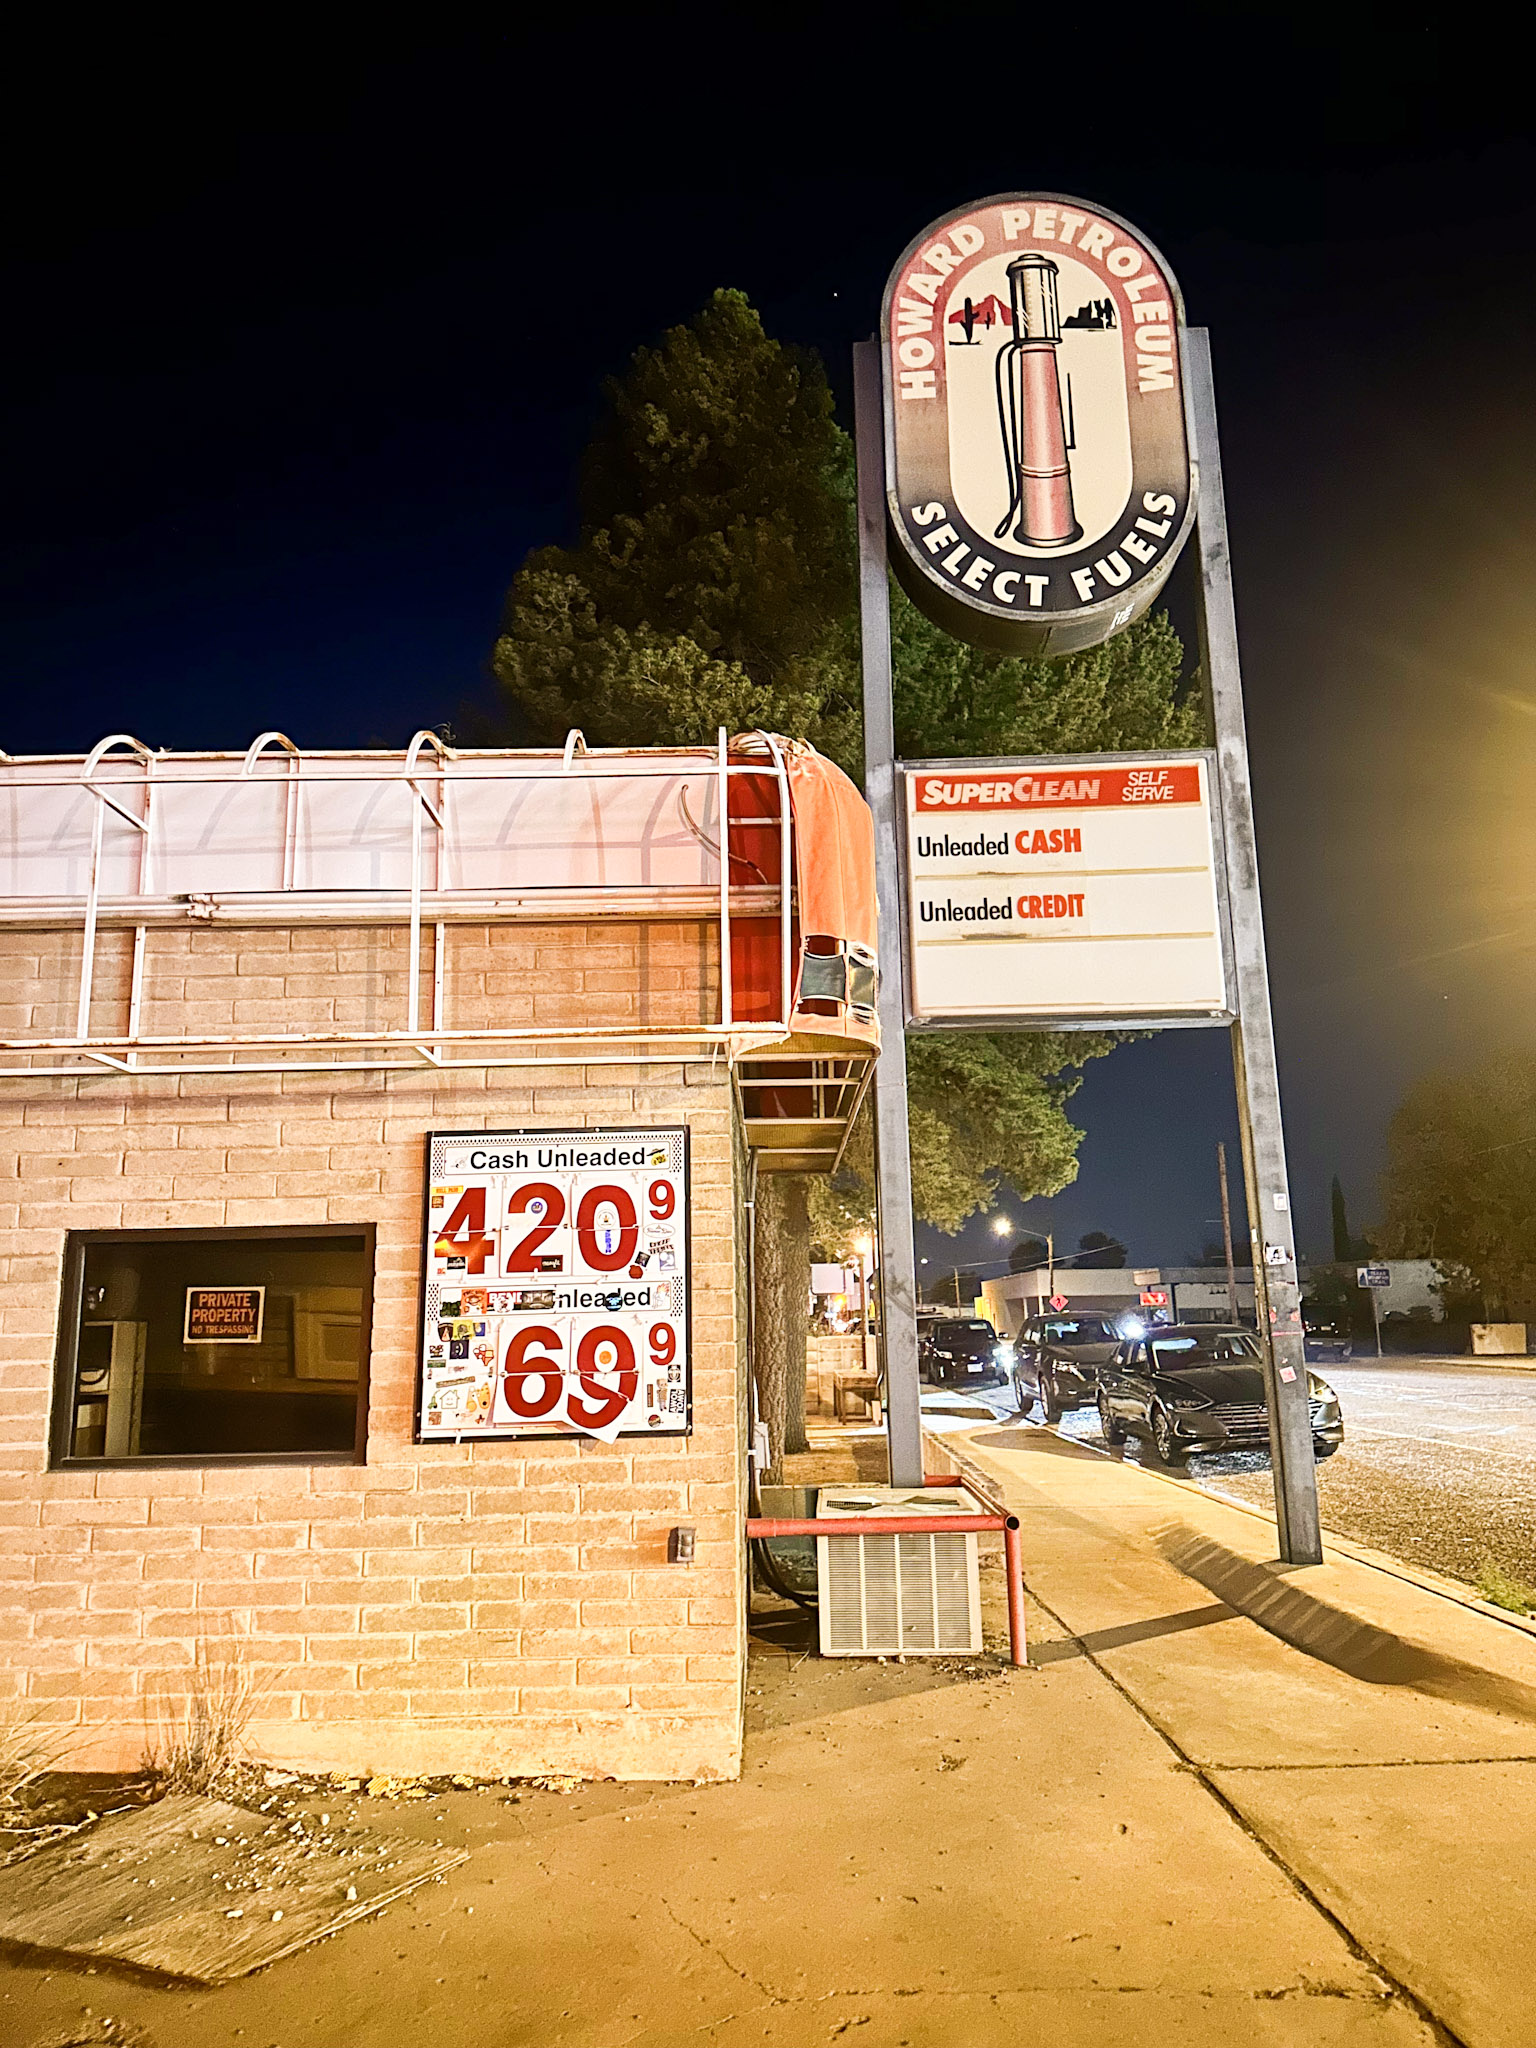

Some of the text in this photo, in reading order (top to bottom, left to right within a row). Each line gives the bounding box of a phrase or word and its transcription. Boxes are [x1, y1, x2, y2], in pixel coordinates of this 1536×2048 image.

[898, 208, 1174, 400] HOWARD PETROLEUM
[911, 491, 1177, 607] SELECT FUELS
[1128, 771, 1169, 787] SELF
[1122, 785, 1175, 802] SERVE
[917, 828, 1082, 857] Unleaded CASH
[920, 894, 1085, 922] Unleaded CREDIT
[470, 1147, 645, 1170] Cash Unleaded
[199, 1293, 252, 1307] PRIVATE
[558, 1287, 651, 1308] nleaed
[191, 1308, 256, 1322] PROPERTY
[191, 1325, 255, 1334] NO TRESPASSING
